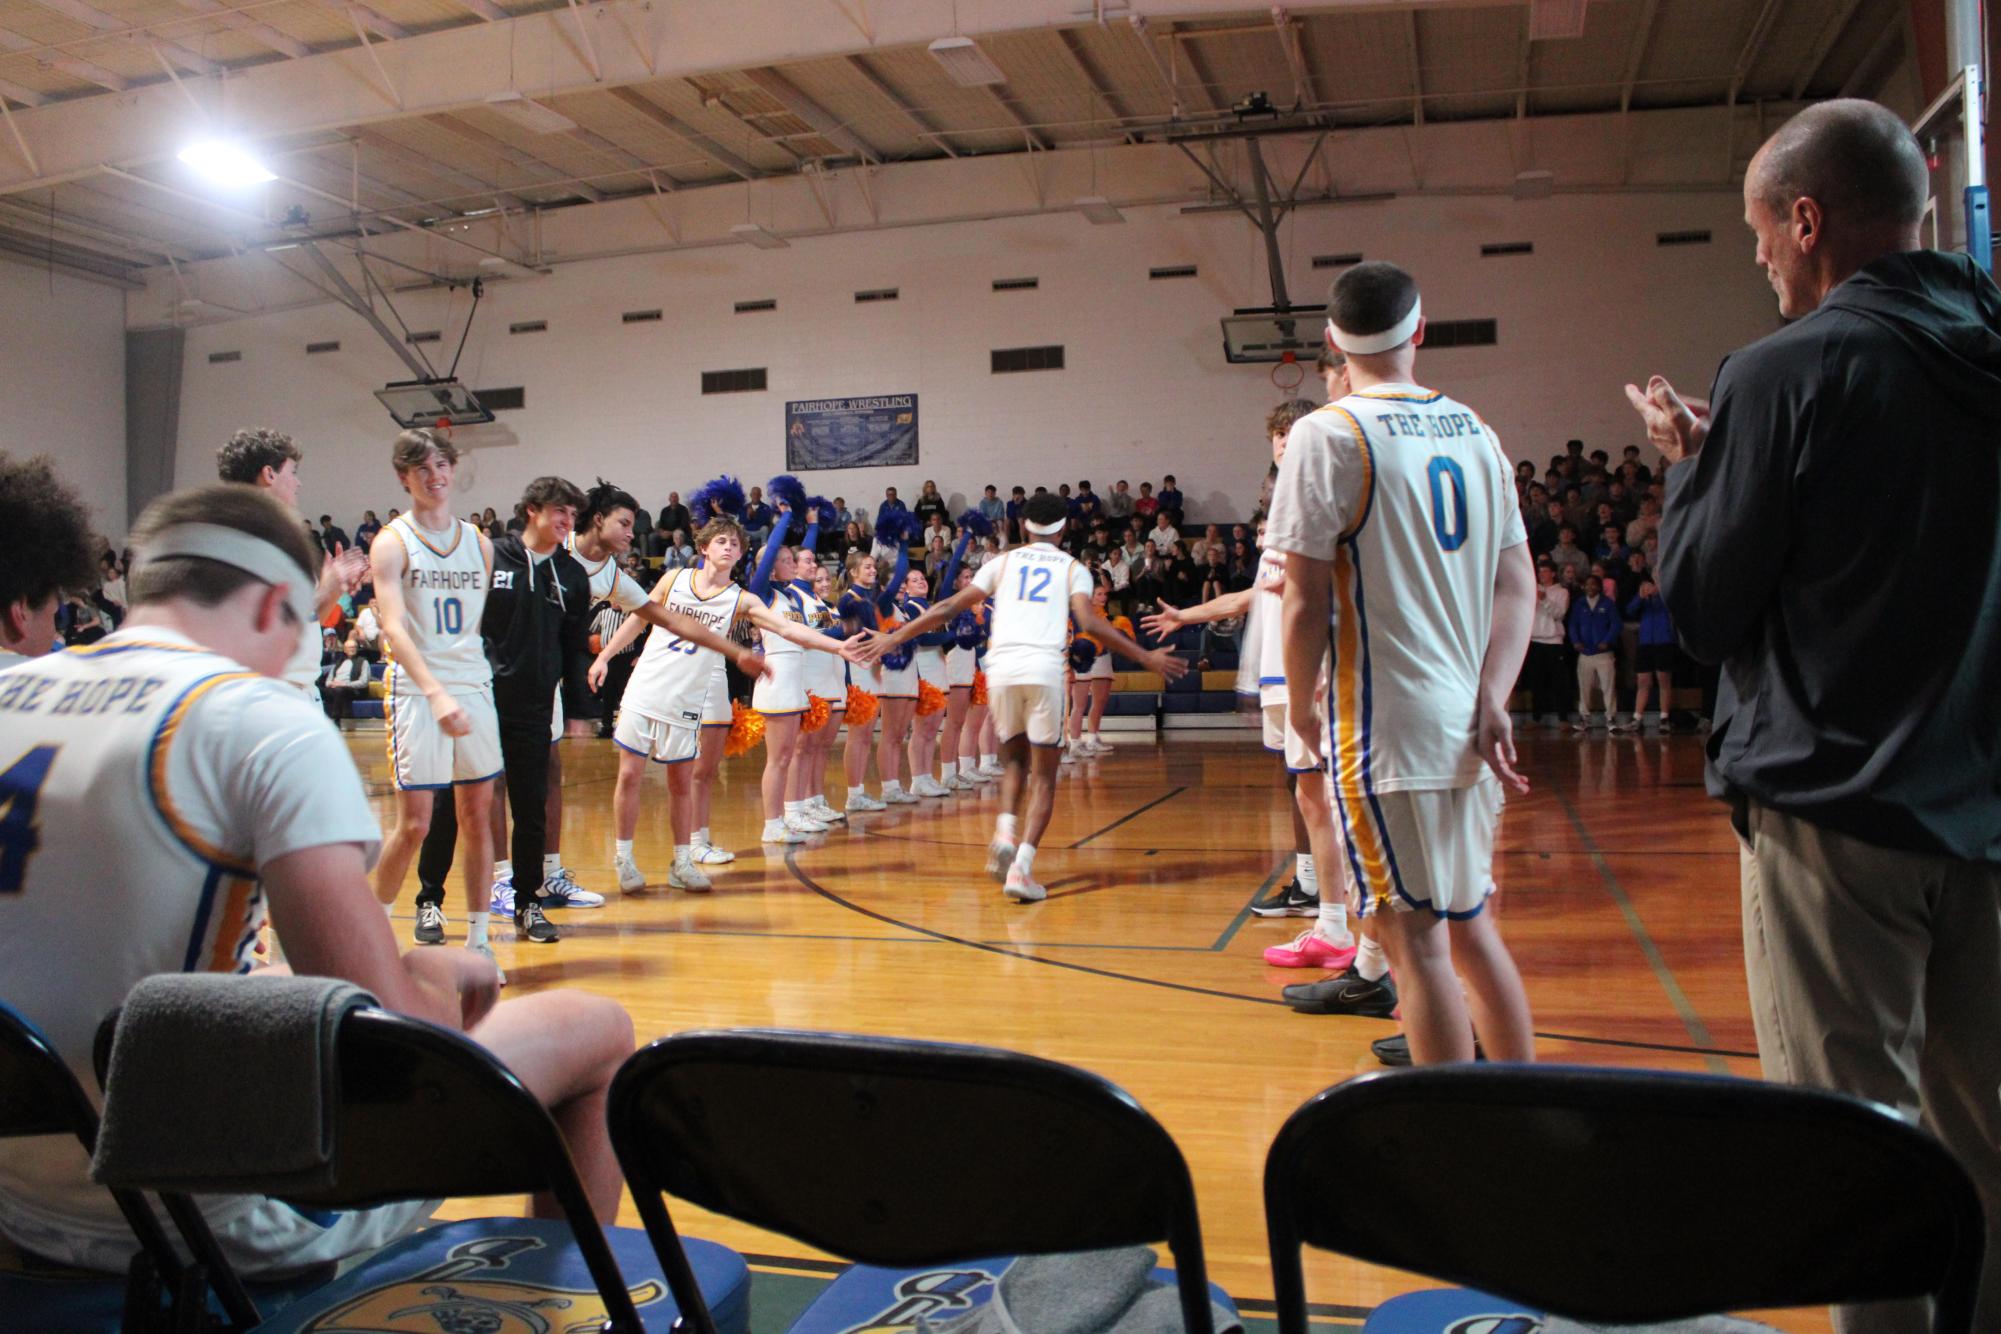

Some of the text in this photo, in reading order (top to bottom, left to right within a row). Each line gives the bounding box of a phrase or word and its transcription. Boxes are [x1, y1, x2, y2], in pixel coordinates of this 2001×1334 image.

[792, 400, 845, 414] FAIRHOPE
[849, 395, 912, 410] WRESTLING
[1377, 413, 1480, 438] THE HOPE
[1427, 456, 1468, 552] 0
[411, 569, 481, 590] FARHOPE
[493, 570, 514, 590] 21
[1018, 565, 1052, 603] 12
[434, 597, 463, 635] 10
[48, 677, 167, 715] HOPE
